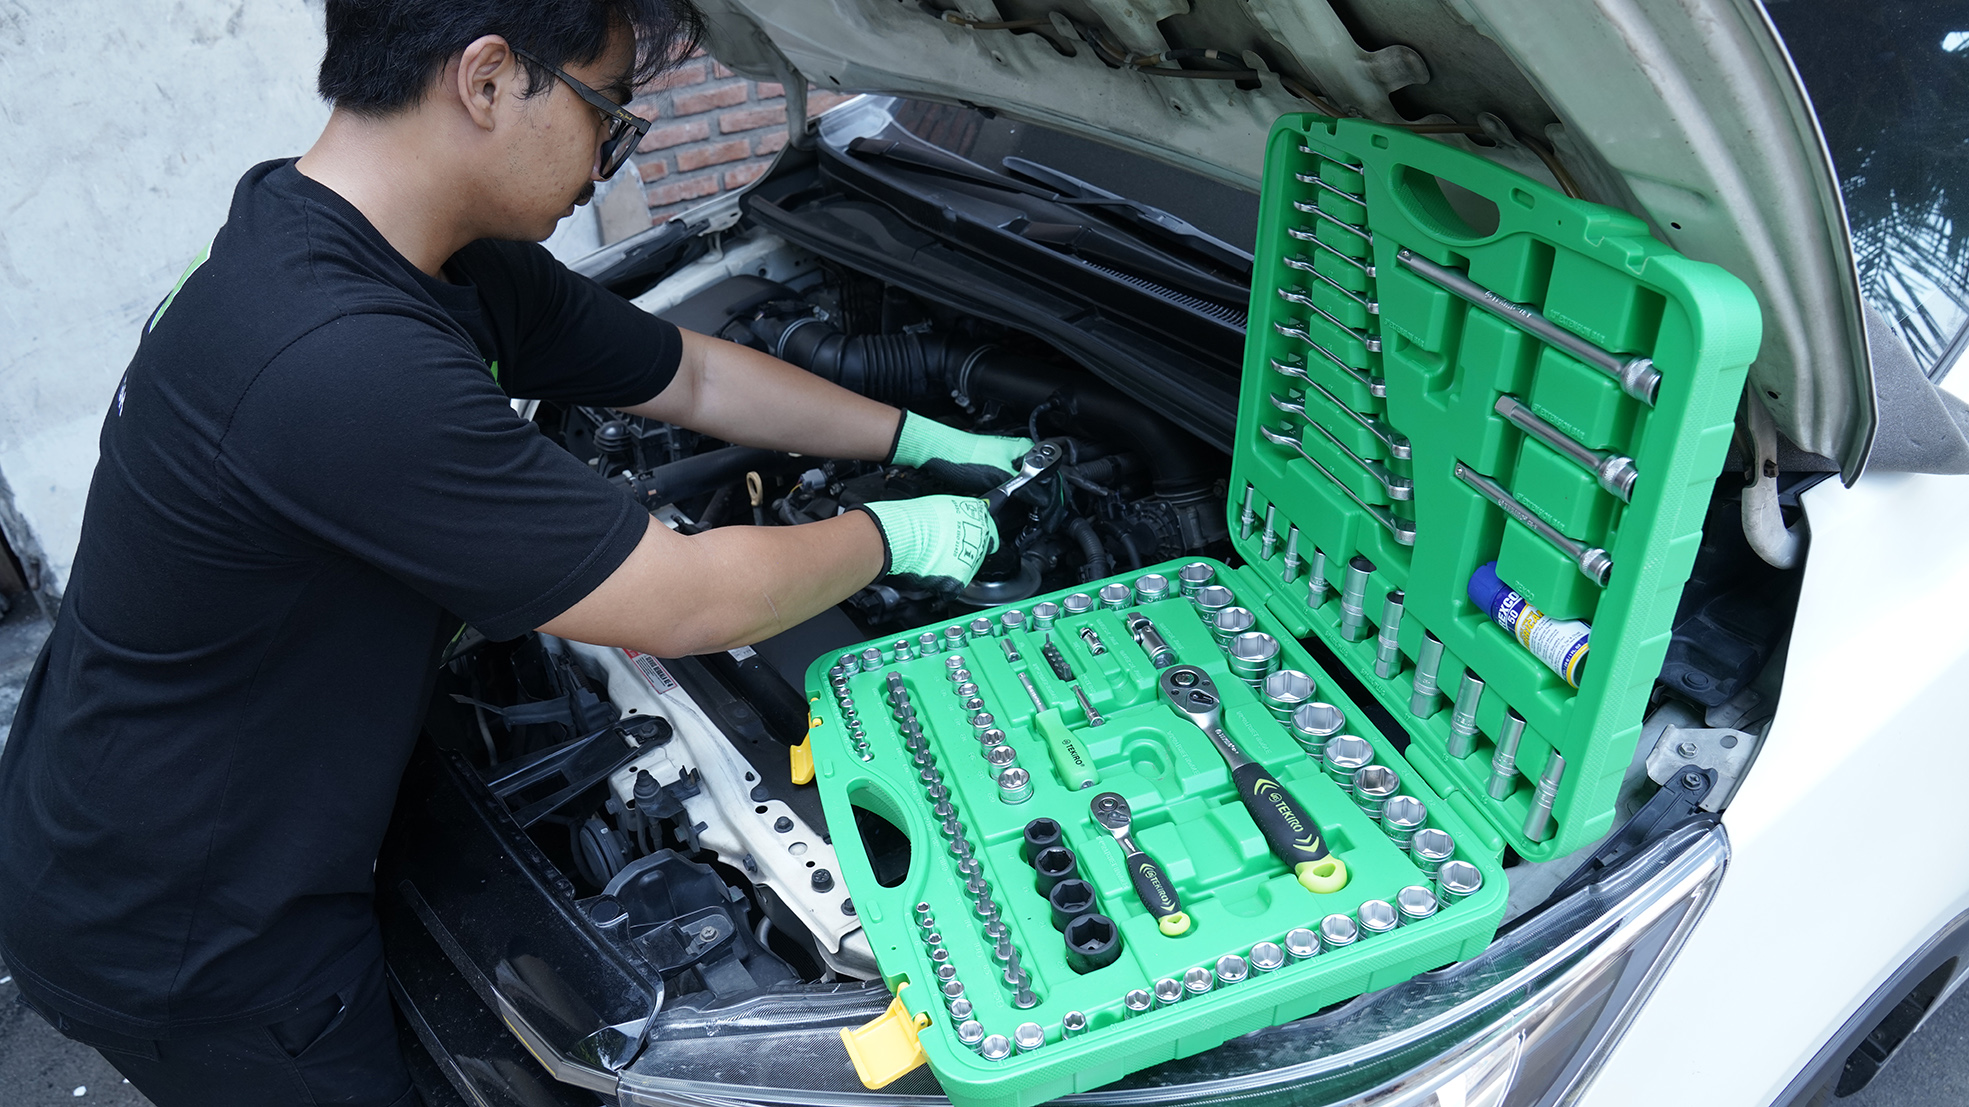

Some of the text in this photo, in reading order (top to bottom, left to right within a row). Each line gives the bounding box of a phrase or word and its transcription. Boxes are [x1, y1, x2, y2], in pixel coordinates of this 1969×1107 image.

[1507, 610, 1519, 625] 50
[1066, 744, 1083, 765] TEKIRO
[1275, 800, 1304, 832] TEKIRO
[1150, 877, 1169, 902] TEKIRO
